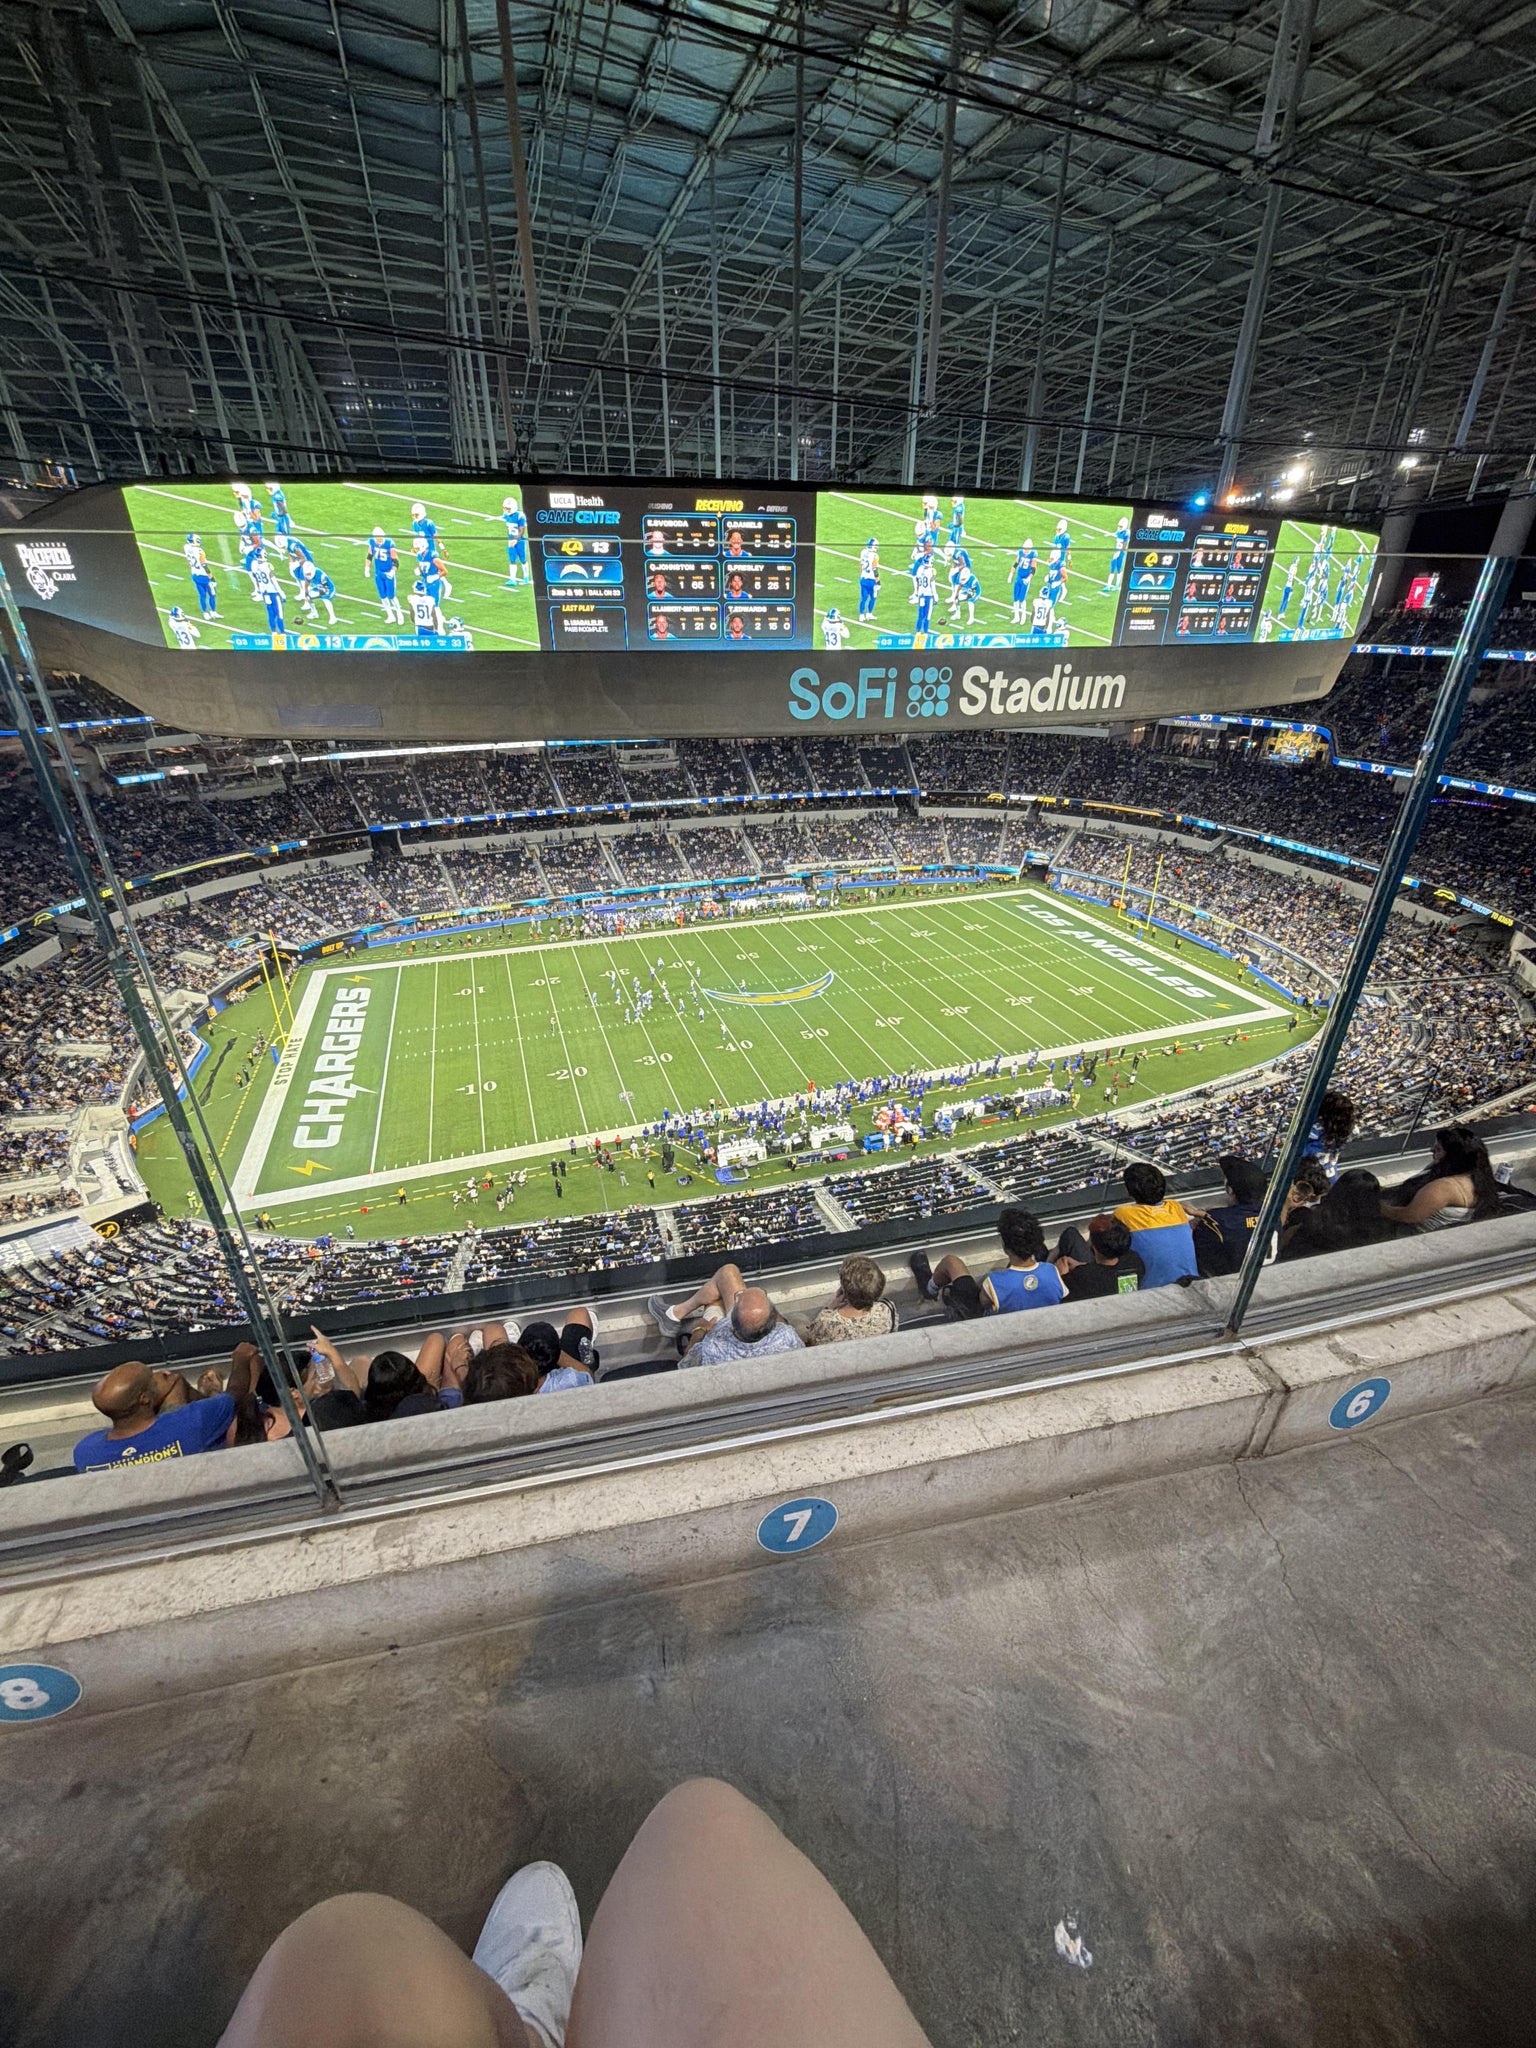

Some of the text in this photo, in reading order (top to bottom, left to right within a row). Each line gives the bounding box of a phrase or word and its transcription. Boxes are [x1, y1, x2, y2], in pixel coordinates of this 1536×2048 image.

[576, 495, 604, 506] Health
[695, 499, 744, 512] RECEIVING
[536, 510, 620, 524] GAME CENTER
[1136, 529, 1185, 541] GAME CENTER
[592, 541, 609, 553] 13
[592, 565, 603, 577] 7
[679, 581, 684, 589] 1
[691, 581, 704, 589] 65
[710, 581, 715, 589] 1
[785, 582, 790, 590] 1
[1157, 575, 1165, 585] 7
[417, 604, 431, 620] 51
[578, 604, 595, 612] PLAY
[1037, 606, 1047, 620] 51
[681, 622, 686, 630] 1
[694, 622, 704, 630] 21
[709, 622, 717, 630] 0
[754, 622, 761, 630] 2
[783, 622, 791, 630] 0
[325, 636, 341, 647] 13
[348, 637, 357, 647] 7
[958, 636, 973, 647] 13
[977, 636, 986, 647] 7
[788, 663, 1126, 720] SoFi Stadium
[1016, 904, 1216, 998] LOS ANGELES
[1067, 986, 1092, 996] 10
[1005, 996, 1030, 1007] 20
[940, 1005, 967, 1016] 30
[874, 1015, 900, 1028] 40
[799, 1027, 829, 1040] 50
[722, 1039, 753, 1052] 40
[274, 1037, 303, 1086] STOP HATE
[641, 1052, 673, 1066] 30
[292, 987, 372, 1148] CHARGERS
[555, 1066, 588, 1080] 20
[465, 1081, 498, 1095] 10
[1347, 1389, 1375, 1419] 6
[783, 1509, 813, 1542] 7
[0, 1677, 50, 1710] 8
